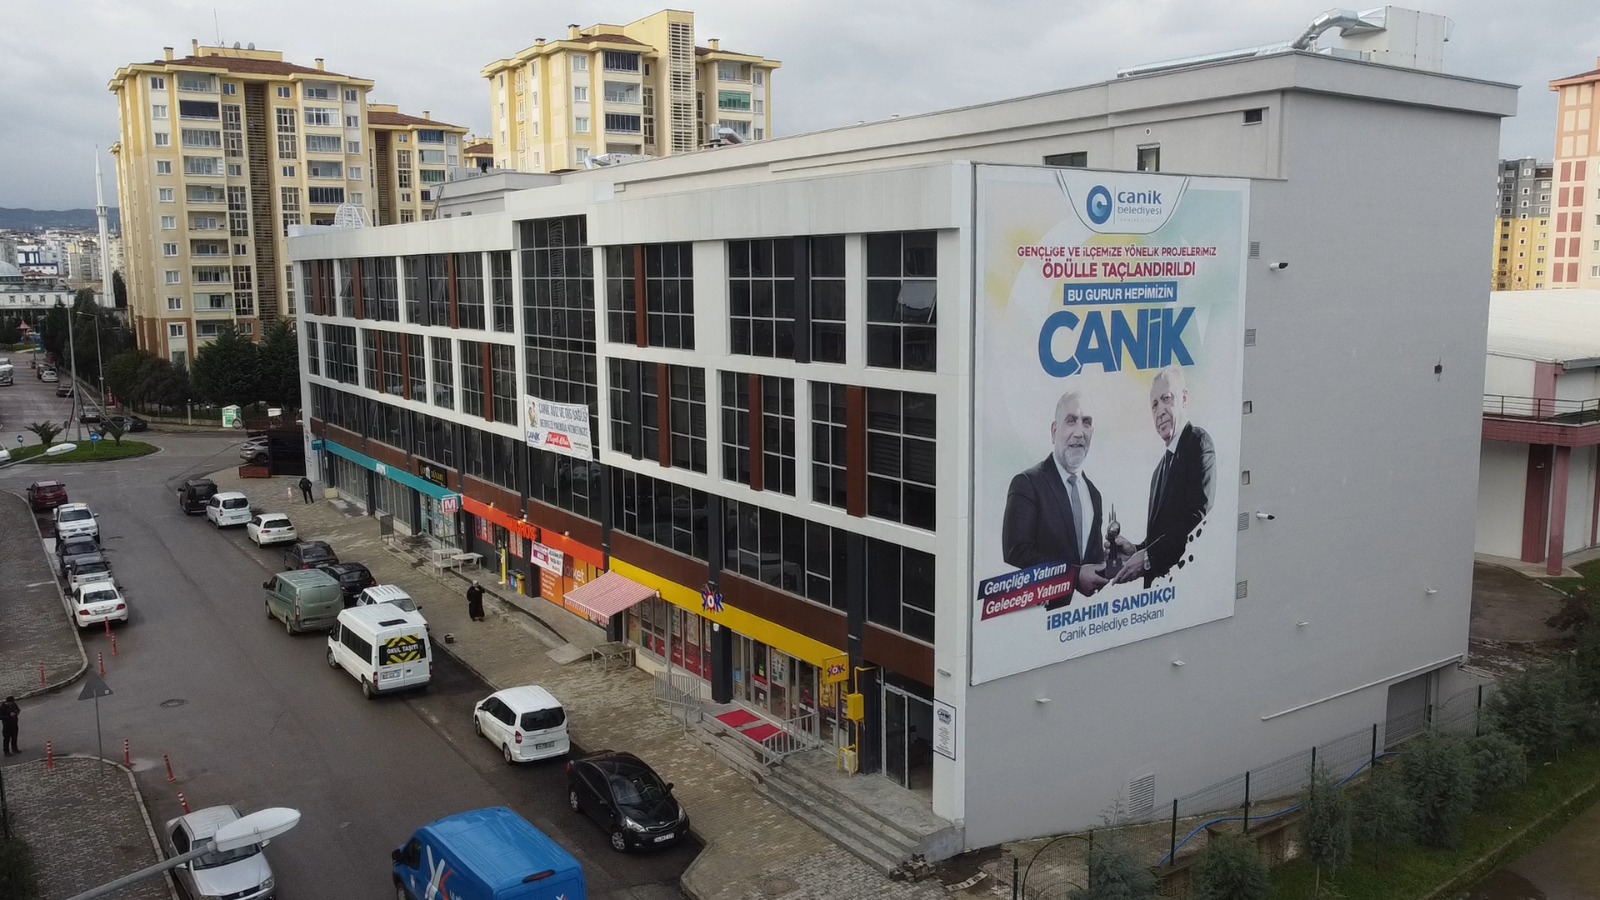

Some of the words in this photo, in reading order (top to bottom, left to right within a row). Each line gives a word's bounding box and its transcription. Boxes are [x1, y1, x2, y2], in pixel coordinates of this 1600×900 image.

[1117, 190, 1162, 205] canik
[1117, 206, 1162, 216] belediyesi
[1068, 246, 1081, 257] VE
[1042, 259, 1098, 279] ÖDÜLLE
[1102, 262, 1196, 282] TAÇLANDIRILDI
[1067, 289, 1083, 302] BU
[1085, 287, 1122, 301] GURUR
[1124, 284, 1174, 300] HEPİMİZİN
[1038, 307, 1196, 378] CANİK
[984, 571, 1030, 596] Gençliğe
[1032, 563, 1067, 581] Yatırım
[986, 590, 1035, 615] Geleceğe
[1037, 581, 1071, 599] Yatırım
[1112, 586, 1175, 614] SANDIKÇI
[1059, 624, 1087, 643] Canik
[1088, 616, 1129, 636] Belediye
[1130, 608, 1165, 626] Başkanı
